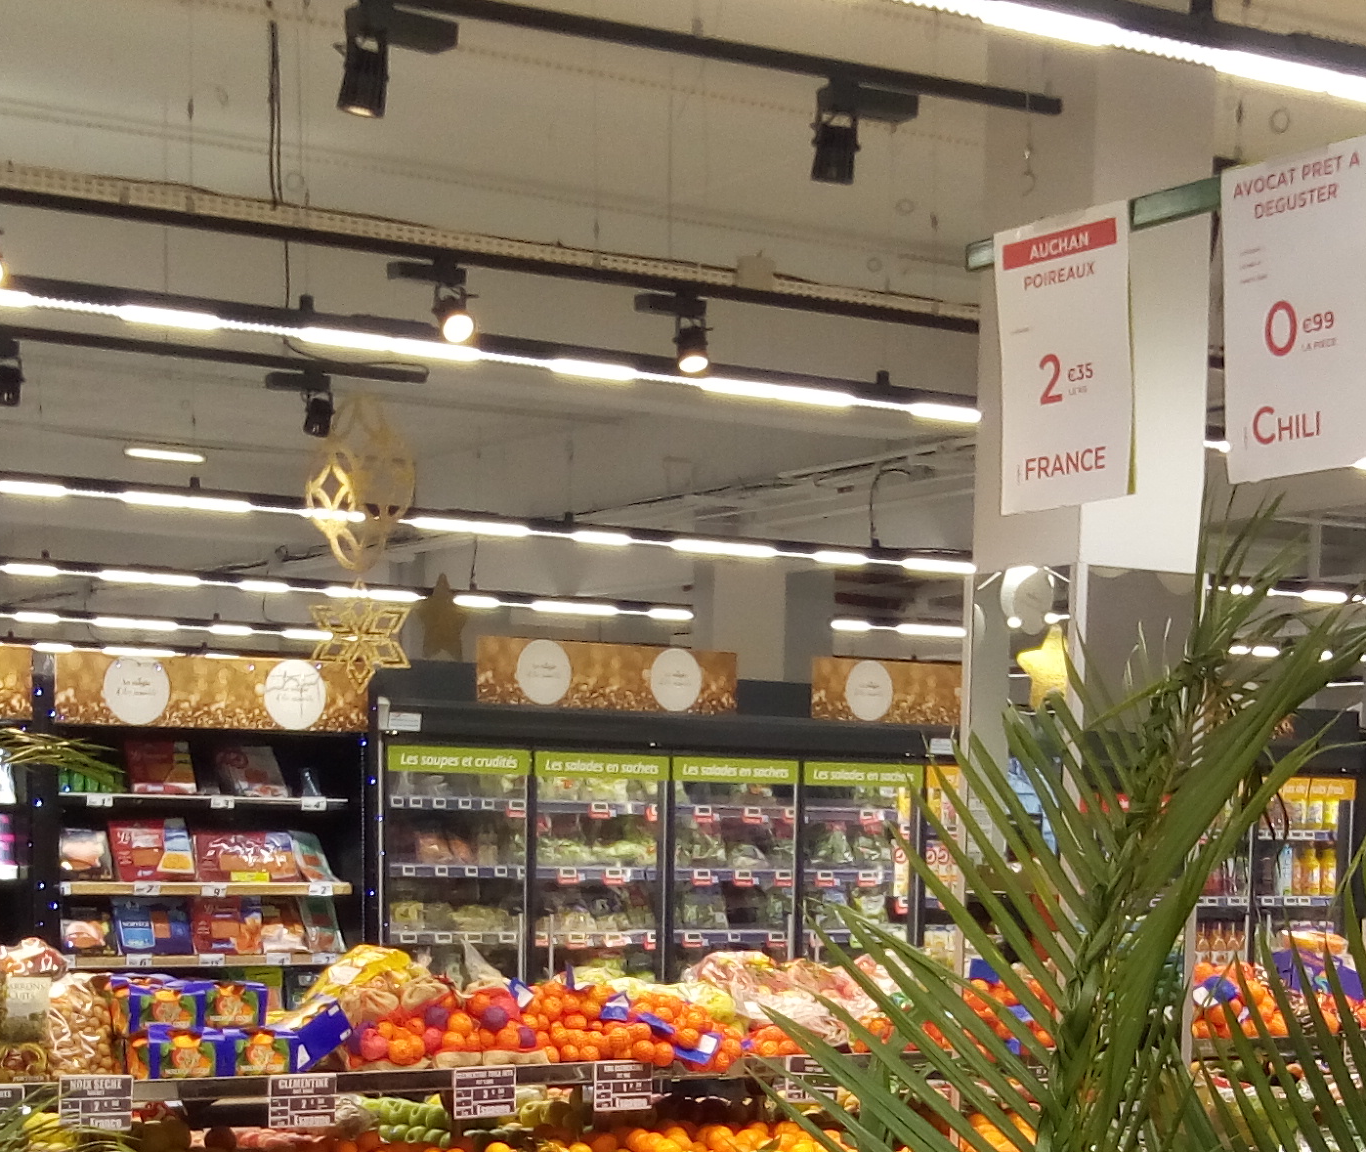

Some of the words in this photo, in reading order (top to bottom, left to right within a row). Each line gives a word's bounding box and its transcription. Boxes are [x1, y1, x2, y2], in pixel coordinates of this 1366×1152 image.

[1233, 168, 1295, 199] AVOCAT
[1301, 155, 1343, 181] PRET
[1349, 151, 1360, 166] A
[1253, 183, 1339, 220] DEGUSTER
[1029, 232, 1089, 261] AUCHAN
[1024, 261, 1095, 291] POIREAUX
[1025, 446, 1106, 481] FRANCE
[401, 752, 418, 765] Les
[421, 754, 459, 767] soupes
[462, 754, 472, 766] et
[475, 754, 518, 769] crudités
[545, 759, 563, 771] Les
[564, 759, 604, 773] salades
[606, 762, 618, 772] en
[621, 760, 659, 774] sachets
[683, 763, 699, 775] Les
[701, 764, 736, 777] salades
[738, 766, 751, 777] en
[753, 765, 789, 779] sachets
[813, 768, 829, 780] Les
[831, 768, 865, 781] salades
[867, 770, 878, 781] en
[70, 1080, 93, 1090] NOIX
[94, 1079, 122, 1090] SECHE
[278, 1077, 329, 1090] CLEMENTINE
